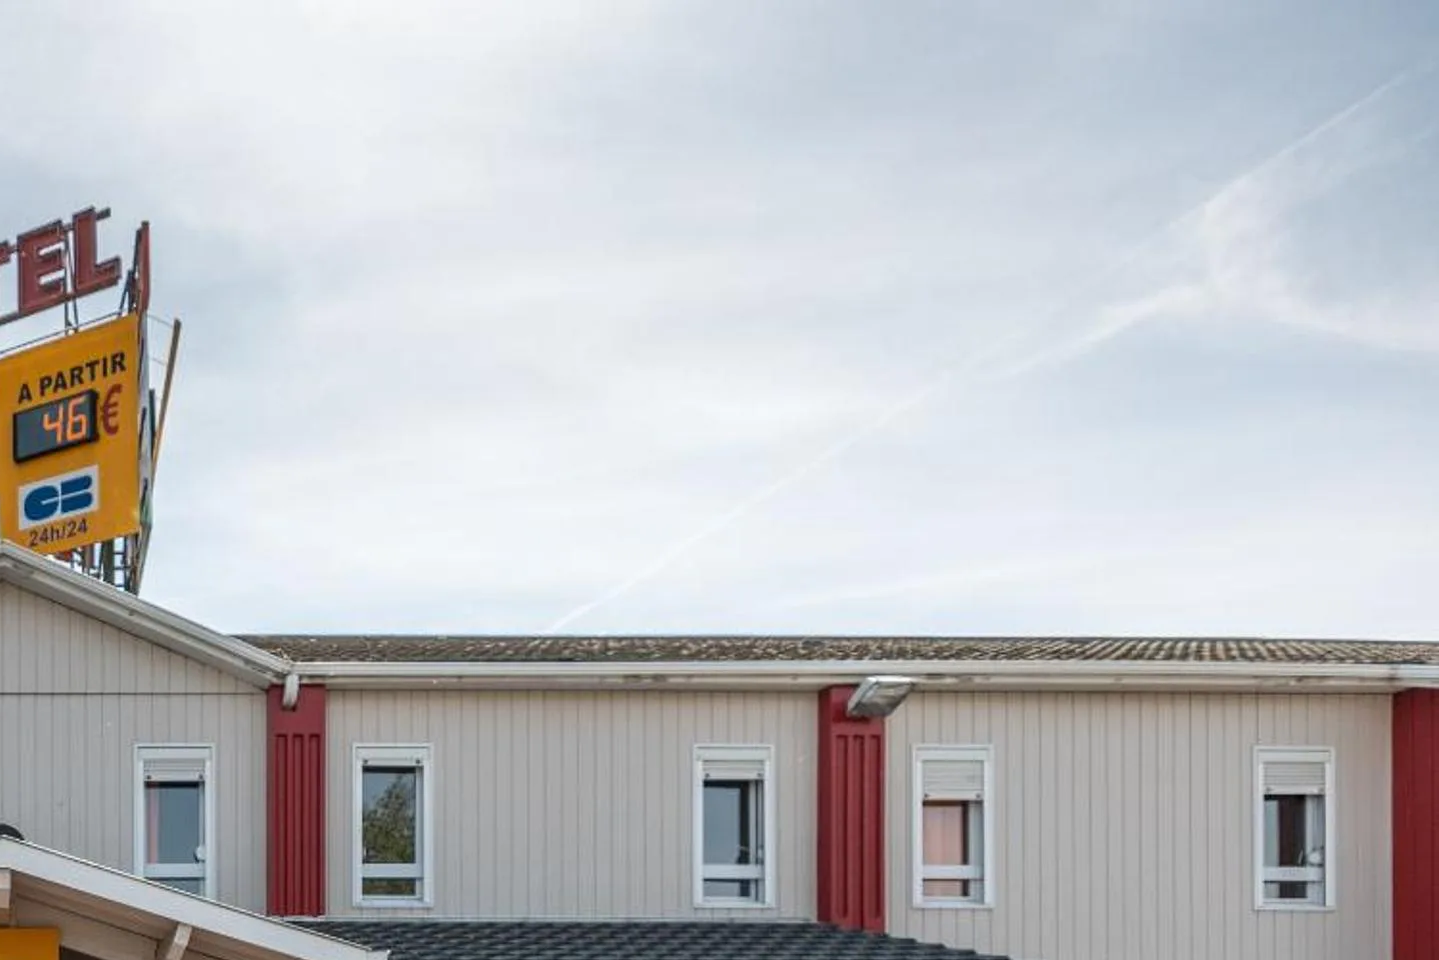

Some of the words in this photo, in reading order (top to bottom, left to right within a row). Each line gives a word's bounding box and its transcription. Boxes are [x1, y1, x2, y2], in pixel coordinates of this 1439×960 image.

[18, 383, 33, 404] A
[40, 352, 127, 398] PARTIR
[43, 396, 89, 444] 46
[29, 517, 89, 547] 24h/24
